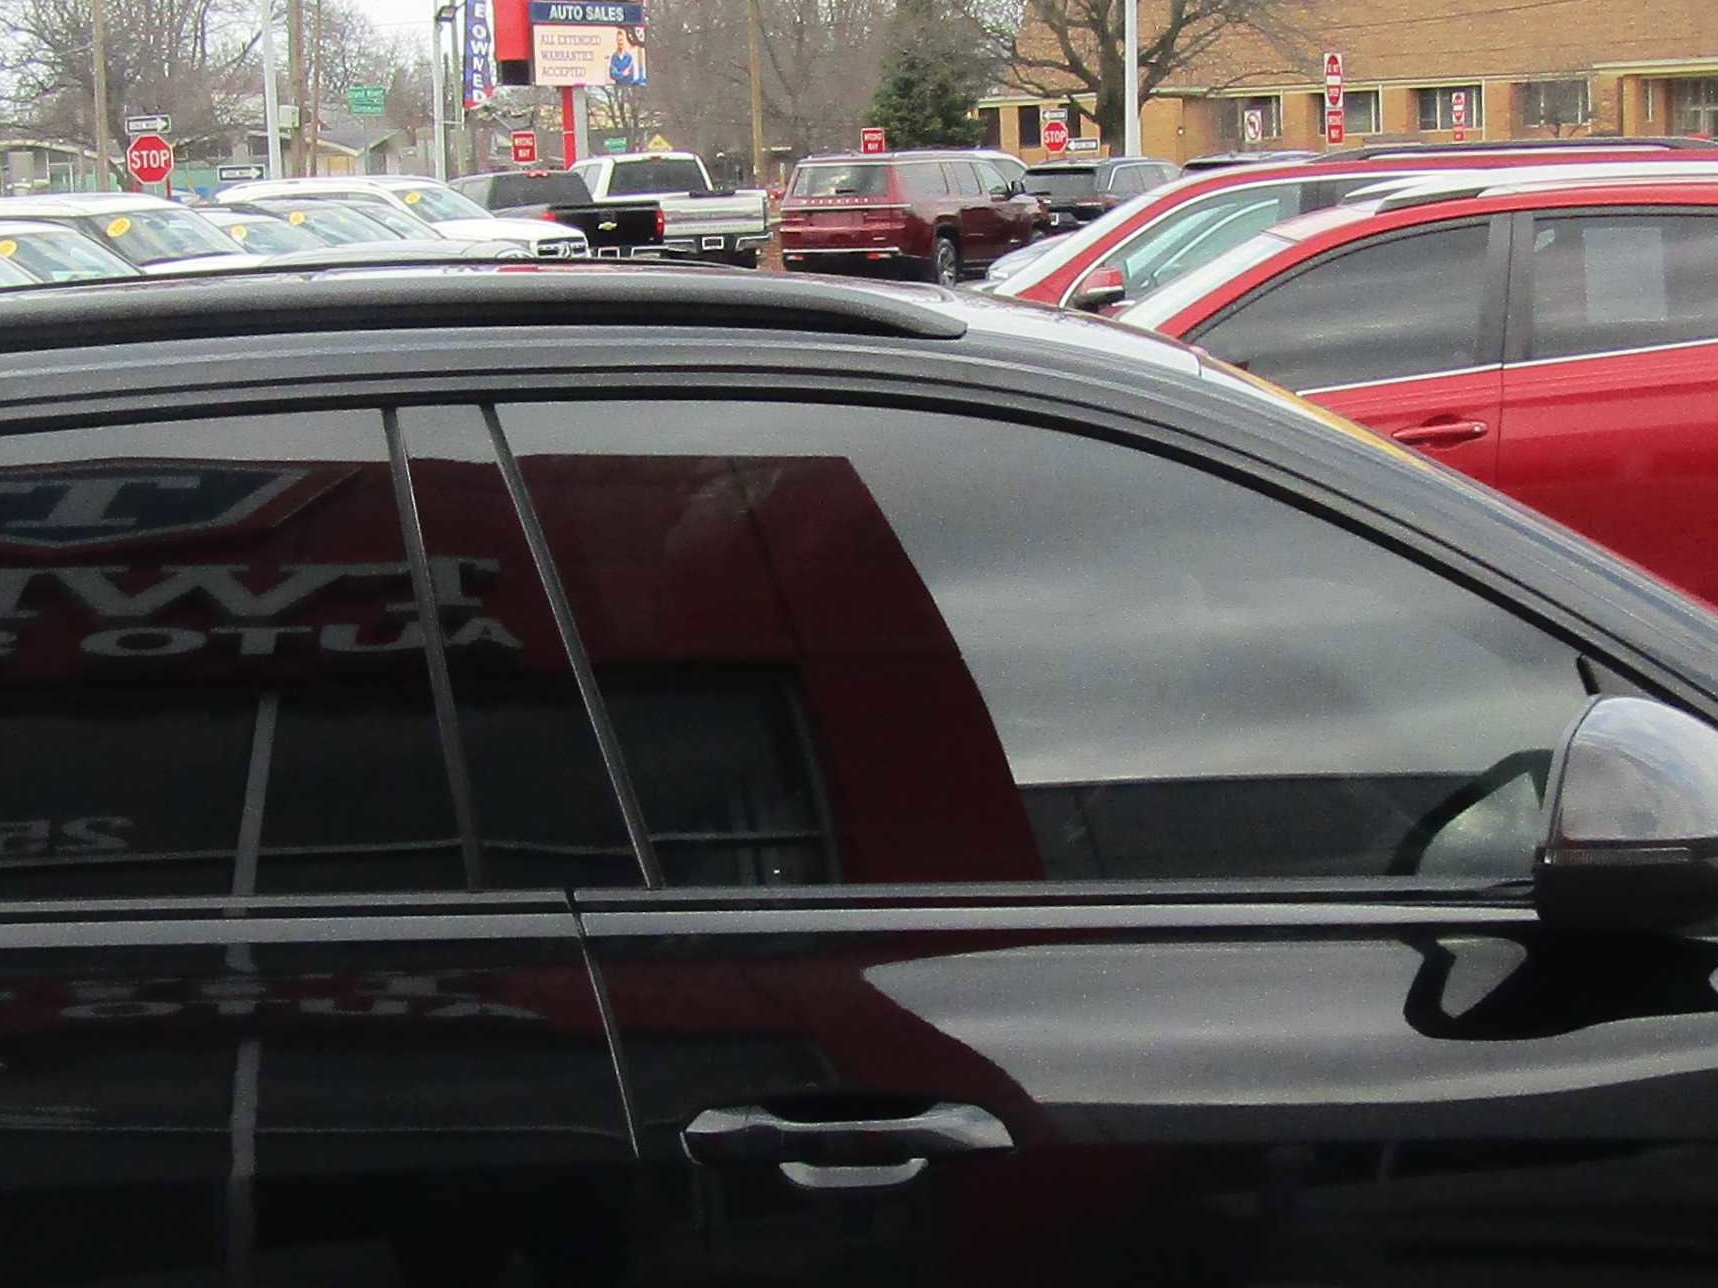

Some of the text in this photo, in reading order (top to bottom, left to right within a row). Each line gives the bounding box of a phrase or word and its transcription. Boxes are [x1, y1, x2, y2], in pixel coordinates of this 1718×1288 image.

[549, 5, 624, 21] AUTO SALES
[470, 24, 489, 103] OWNED
[1043, 130, 1066, 144] STOP
[131, 149, 170, 169] STOP
